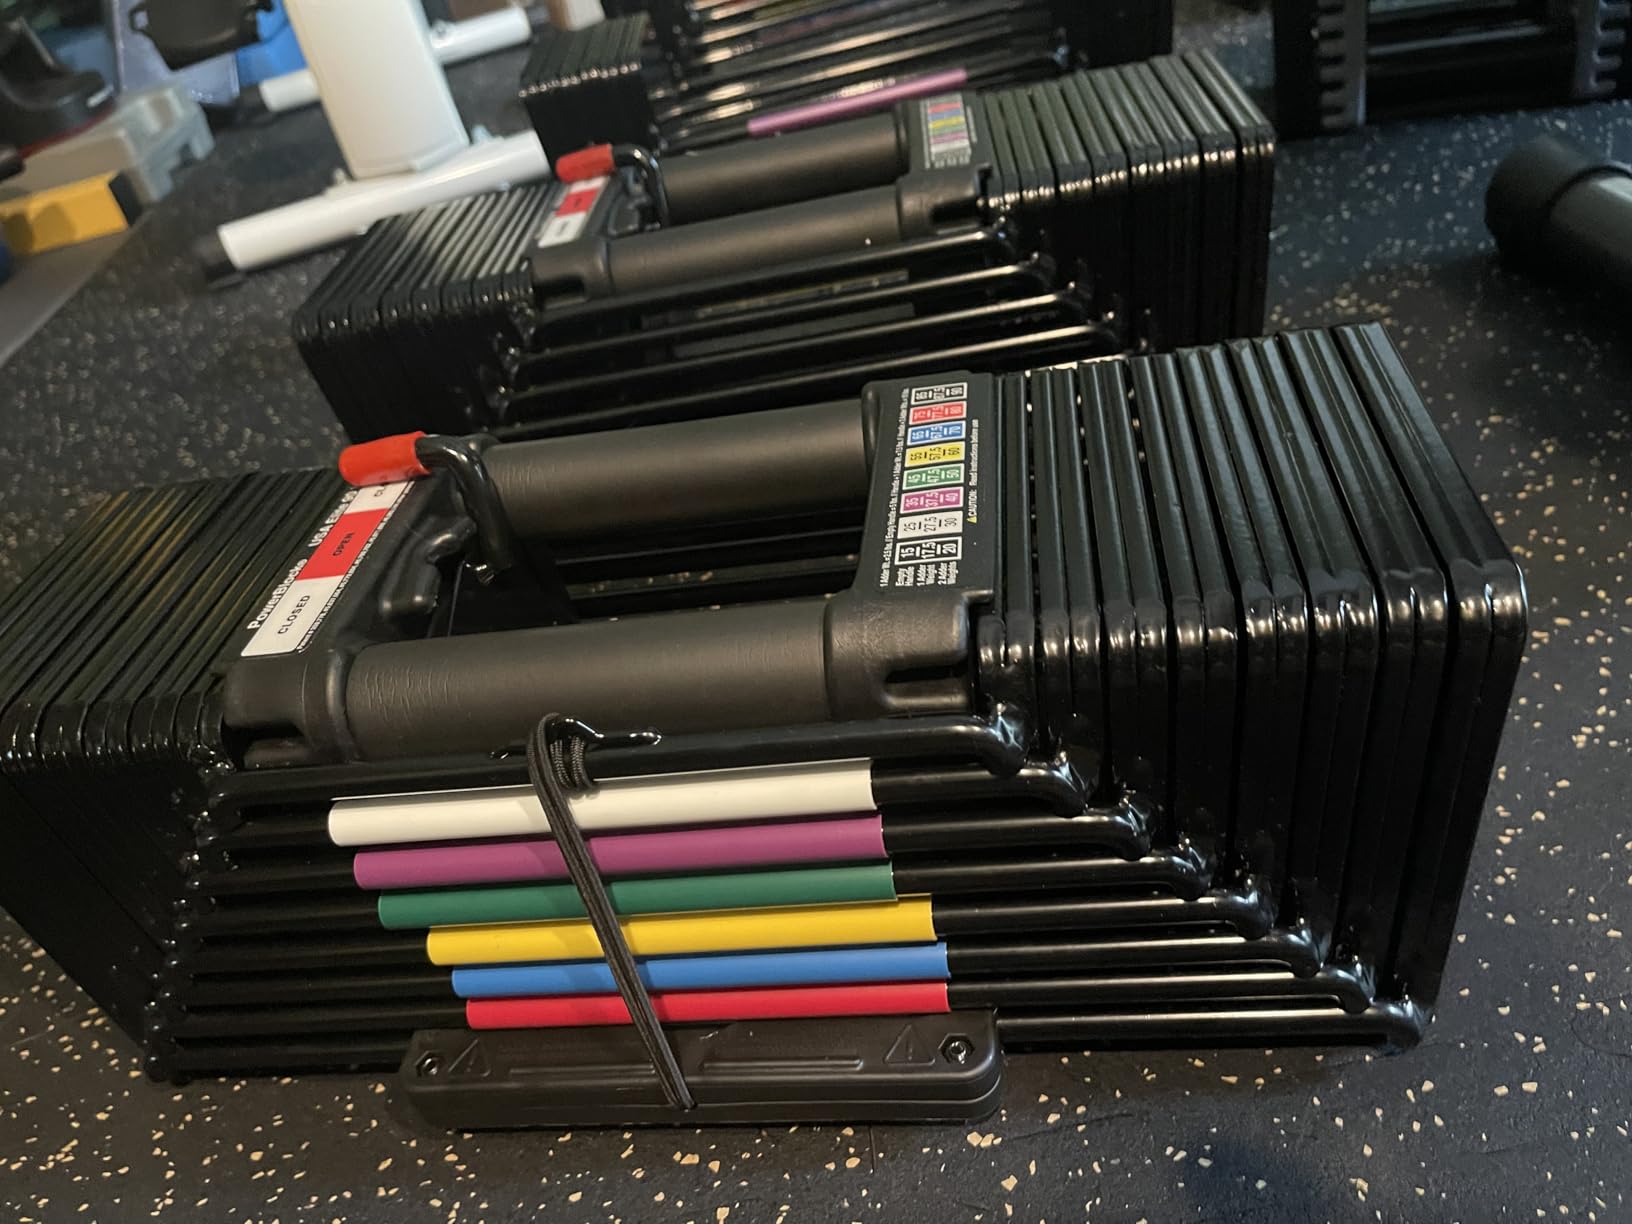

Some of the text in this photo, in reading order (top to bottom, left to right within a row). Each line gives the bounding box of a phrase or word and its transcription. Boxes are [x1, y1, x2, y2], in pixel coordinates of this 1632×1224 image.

[948, 425, 961, 435] 70
[910, 452, 922, 461] 55
[928, 447, 942, 461] 57.5
[908, 474, 920, 483] 45
[927, 468, 940, 483] 47.5
[946, 469, 959, 478] 50
[905, 497, 919, 507] 35
[925, 492, 939, 507] 37.5
[945, 492, 958, 502] 40
[968, 489, 977, 516] CAUTION:
[904, 522, 917, 532] 25
[923, 516, 937, 532] 27.5
[944, 517, 957, 527] 30
[307, 524, 334, 547] USA
[332, 532, 355, 556] OPEN
[921, 542, 936, 559] 17.5
[942, 543, 957, 554] 20
[901, 547, 914, 558] 15
[895, 567, 907, 586] Empty
[905, 566, 915, 587] Handle
[917, 564, 926, 582] Adder
[926, 564, 937, 585] Weight
[938, 562, 947, 580] Adder
[277, 595, 311, 634] CLOSED
